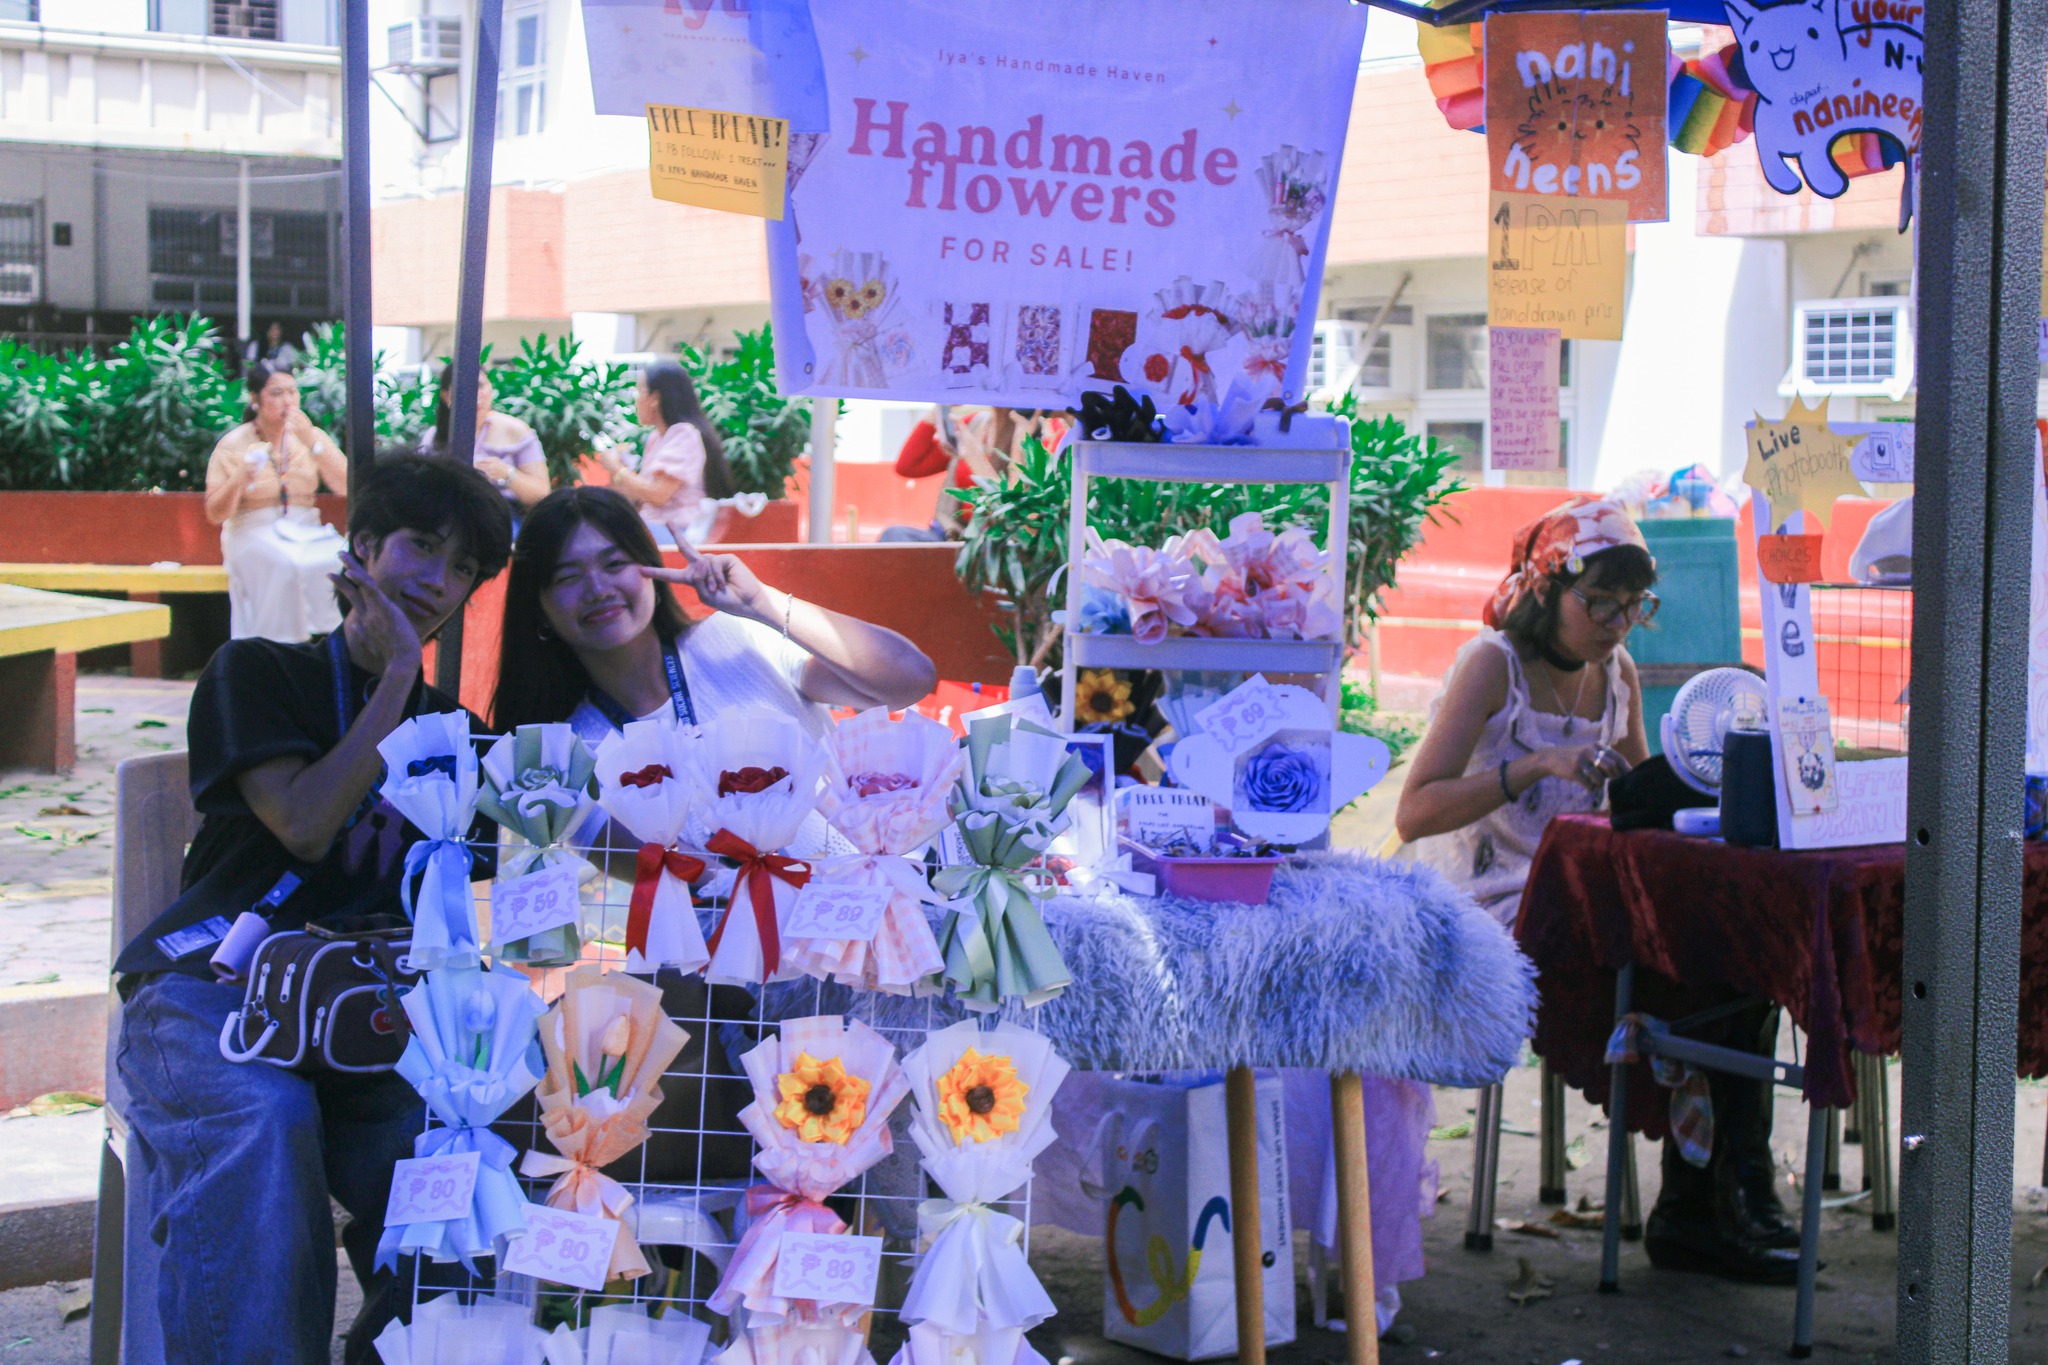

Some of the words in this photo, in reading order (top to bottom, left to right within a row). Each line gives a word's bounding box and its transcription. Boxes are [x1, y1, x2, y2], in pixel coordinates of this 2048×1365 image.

[1852, 0, 1923, 48] your
[938, 48, 986, 66] Iya's
[996, 55, 1097, 77] Handmade
[1107, 65, 1165, 84] Haven
[1516, 39, 1635, 96] nani
[649, 106, 705, 136] FREE
[709, 112, 783, 148] TREAT!
[847, 97, 1239, 186] Handmade
[1504, 142, 1642, 195] neens
[905, 155, 1177, 228] flowers
[940, 236, 1011, 264] FOR
[1030, 242, 1134, 272] SALE!
[1493, 272, 1546, 295] Release
[1556, 268, 1578, 292] of
[1585, 302, 1613, 326] pins
[1757, 425, 1801, 462] Live
[1764, 441, 1849, 503] Photobooth
[1241, 701, 1265, 724] 69
[1839, 770, 1886, 798] LET
[1811, 800, 1888, 842] DRAW
[533, 889, 559, 913] 59
[835, 904, 864, 922] 89
[430, 1177, 457, 1200] 80
[558, 1238, 590, 1262] 80
[825, 1259, 855, 1280] 89
